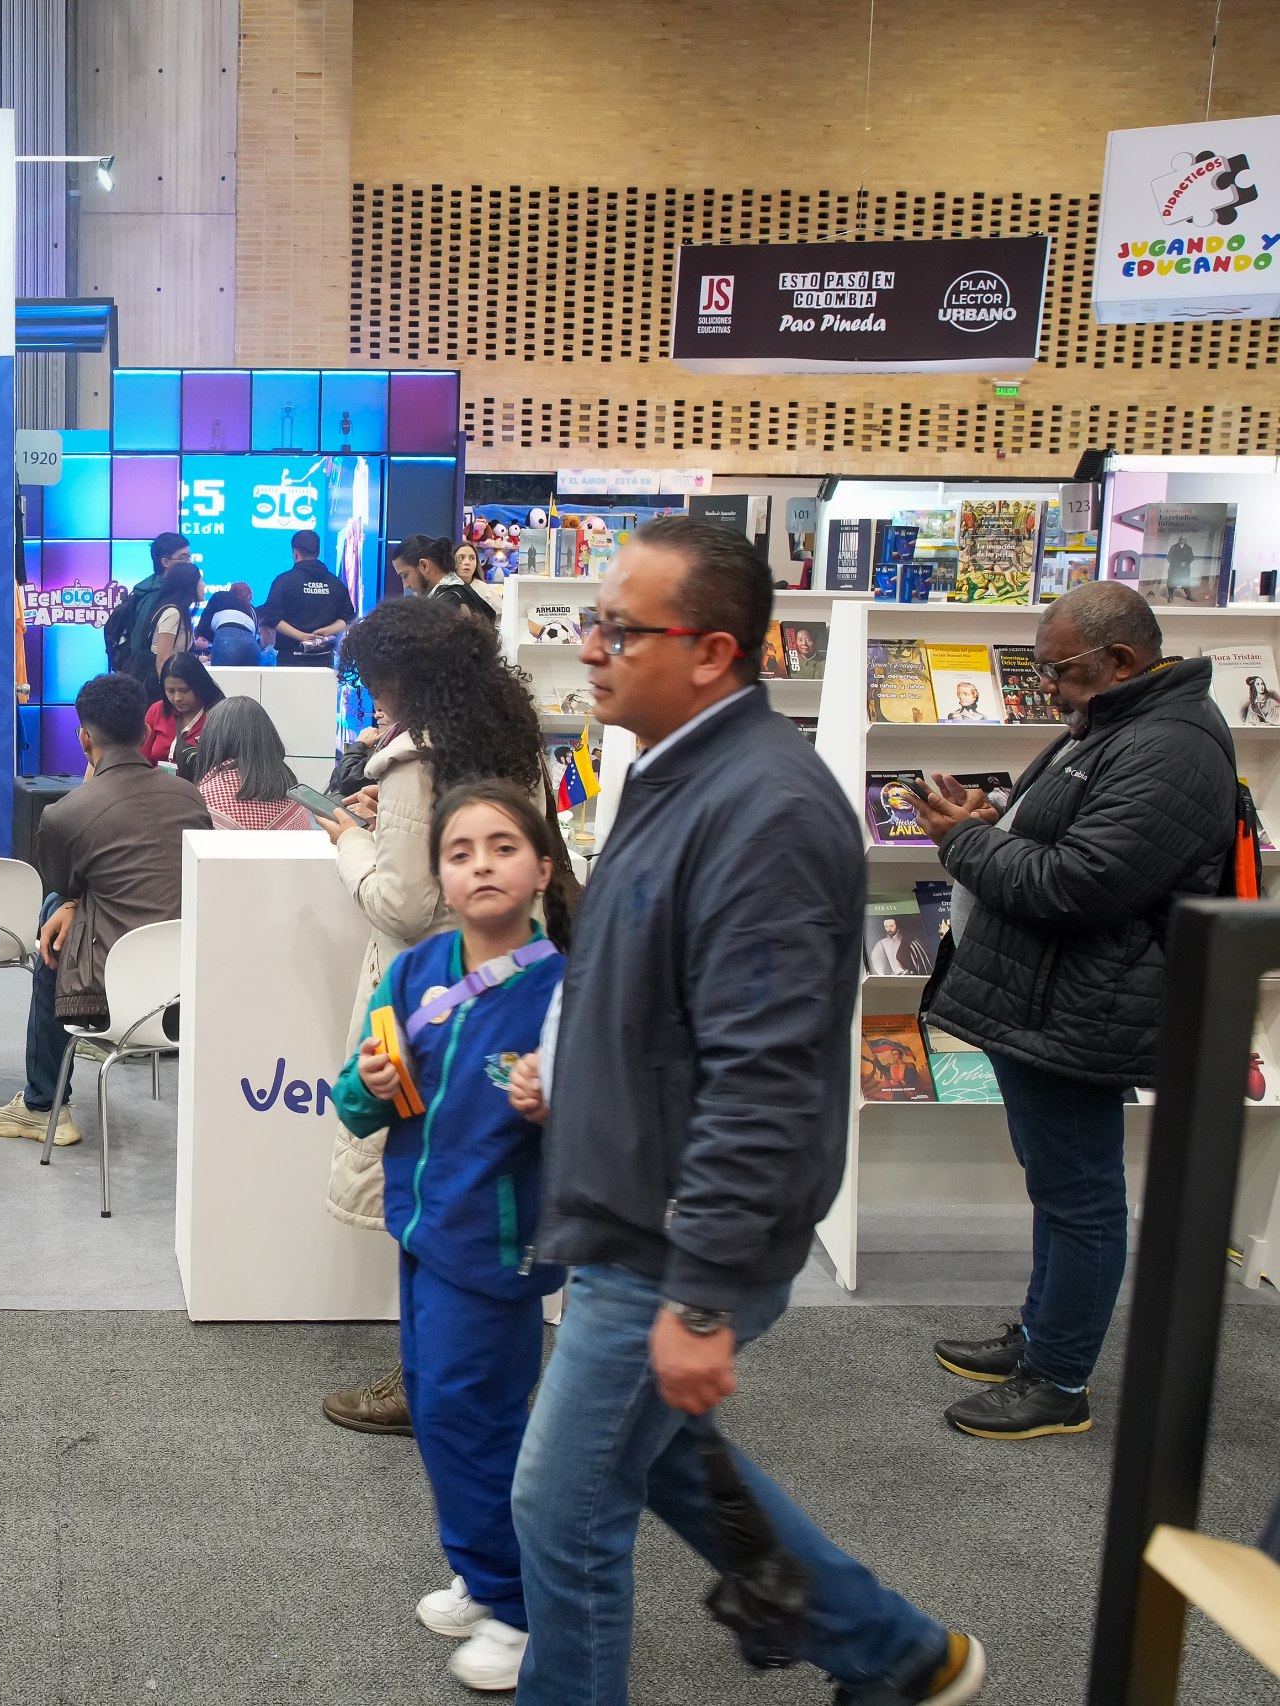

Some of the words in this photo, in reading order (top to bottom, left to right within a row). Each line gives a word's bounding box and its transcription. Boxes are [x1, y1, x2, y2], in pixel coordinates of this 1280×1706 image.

[1162, 158, 1223, 217] DIDACTICOS
[1118, 234, 1246, 259] JUGANDO
[1261, 233, 1280, 251] Y
[1122, 252, 1273, 278] EDUCANDO
[780, 273, 819, 289] ESTO
[825, 272, 868, 289] PASÓ
[873, 272, 894, 288] EN
[959, 279, 997, 291] PLAN
[702, 277, 732, 311] JS
[794, 291, 875, 307] COLOMBIA
[951, 293, 1003, 305] LECTOR
[698, 316, 732, 325] SOLUCIONES
[937, 307, 1017, 321] URBANO
[697, 325, 731, 334] EDUCATIVAS
[778, 313, 816, 332] Pao
[819, 312, 887, 332] Pineda
[22, 451, 58, 466] 1920
[181, 479, 226, 517] 5
[1067, 499, 1091, 514] 123
[793, 510, 810, 520] 101
[303, 587, 330, 595] COLORES
[535, 606, 571, 614] ARMANDO
[789, 650, 801, 672] SEIS
